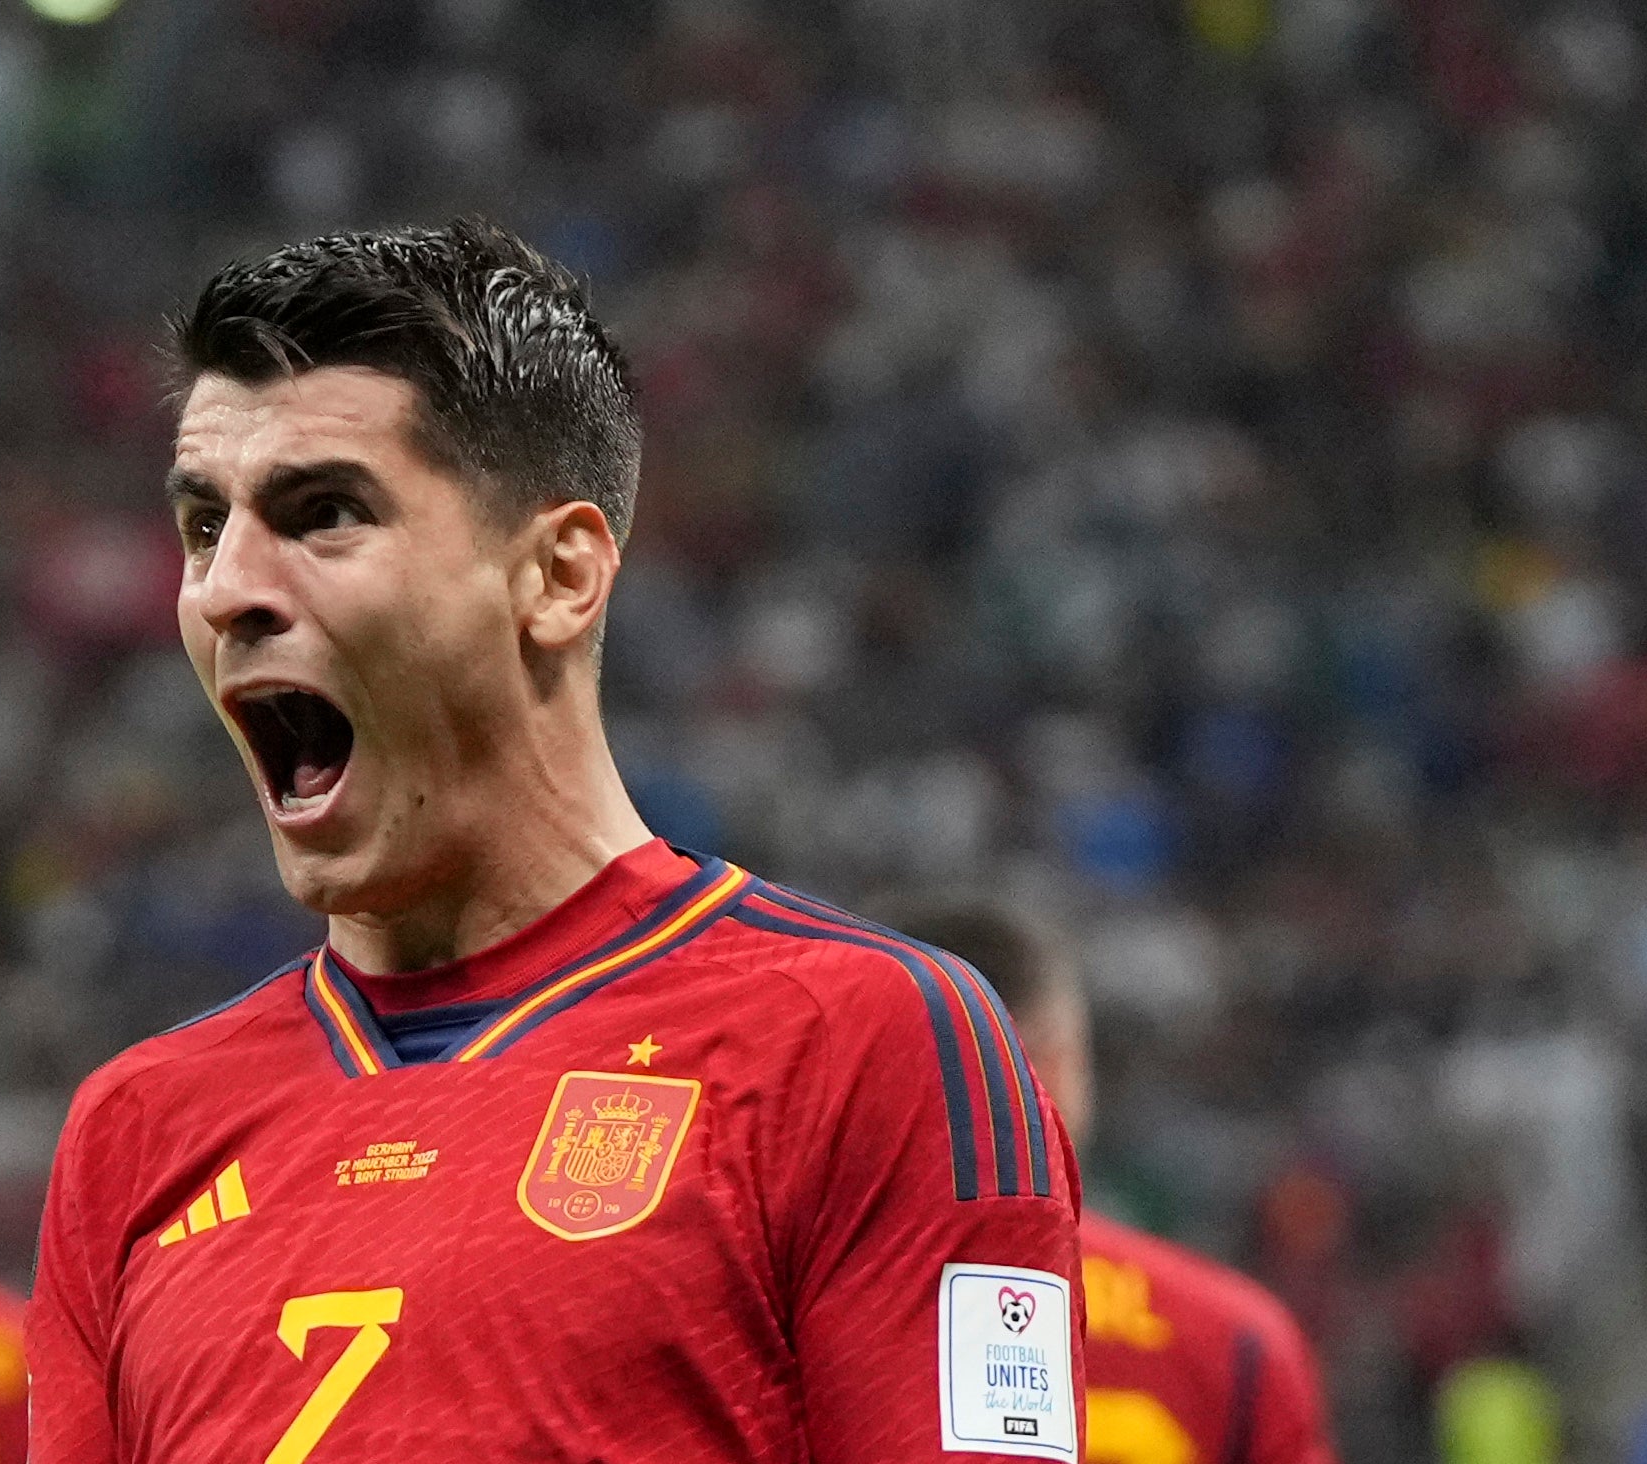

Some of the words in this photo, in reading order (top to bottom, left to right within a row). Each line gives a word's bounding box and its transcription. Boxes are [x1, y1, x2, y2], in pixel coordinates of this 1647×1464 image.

[367, 1141, 417, 1156] GERMANY
[334, 1160, 351, 1174] 27
[352, 1155, 409, 1171] NOVEMBER
[410, 1149, 439, 1166] 2022
[336, 1172, 352, 1186] AL
[353, 1169, 384, 1184] BAYT
[383, 1166, 429, 1181] STADIUM
[986, 1345, 1047, 1365] FOOTBALL
[987, 1364, 1048, 1391] UNITES
[983, 1390, 1009, 1409] the
[1011, 1391, 1055, 1416] World
[1006, 1419, 1037, 1434] FIFA
